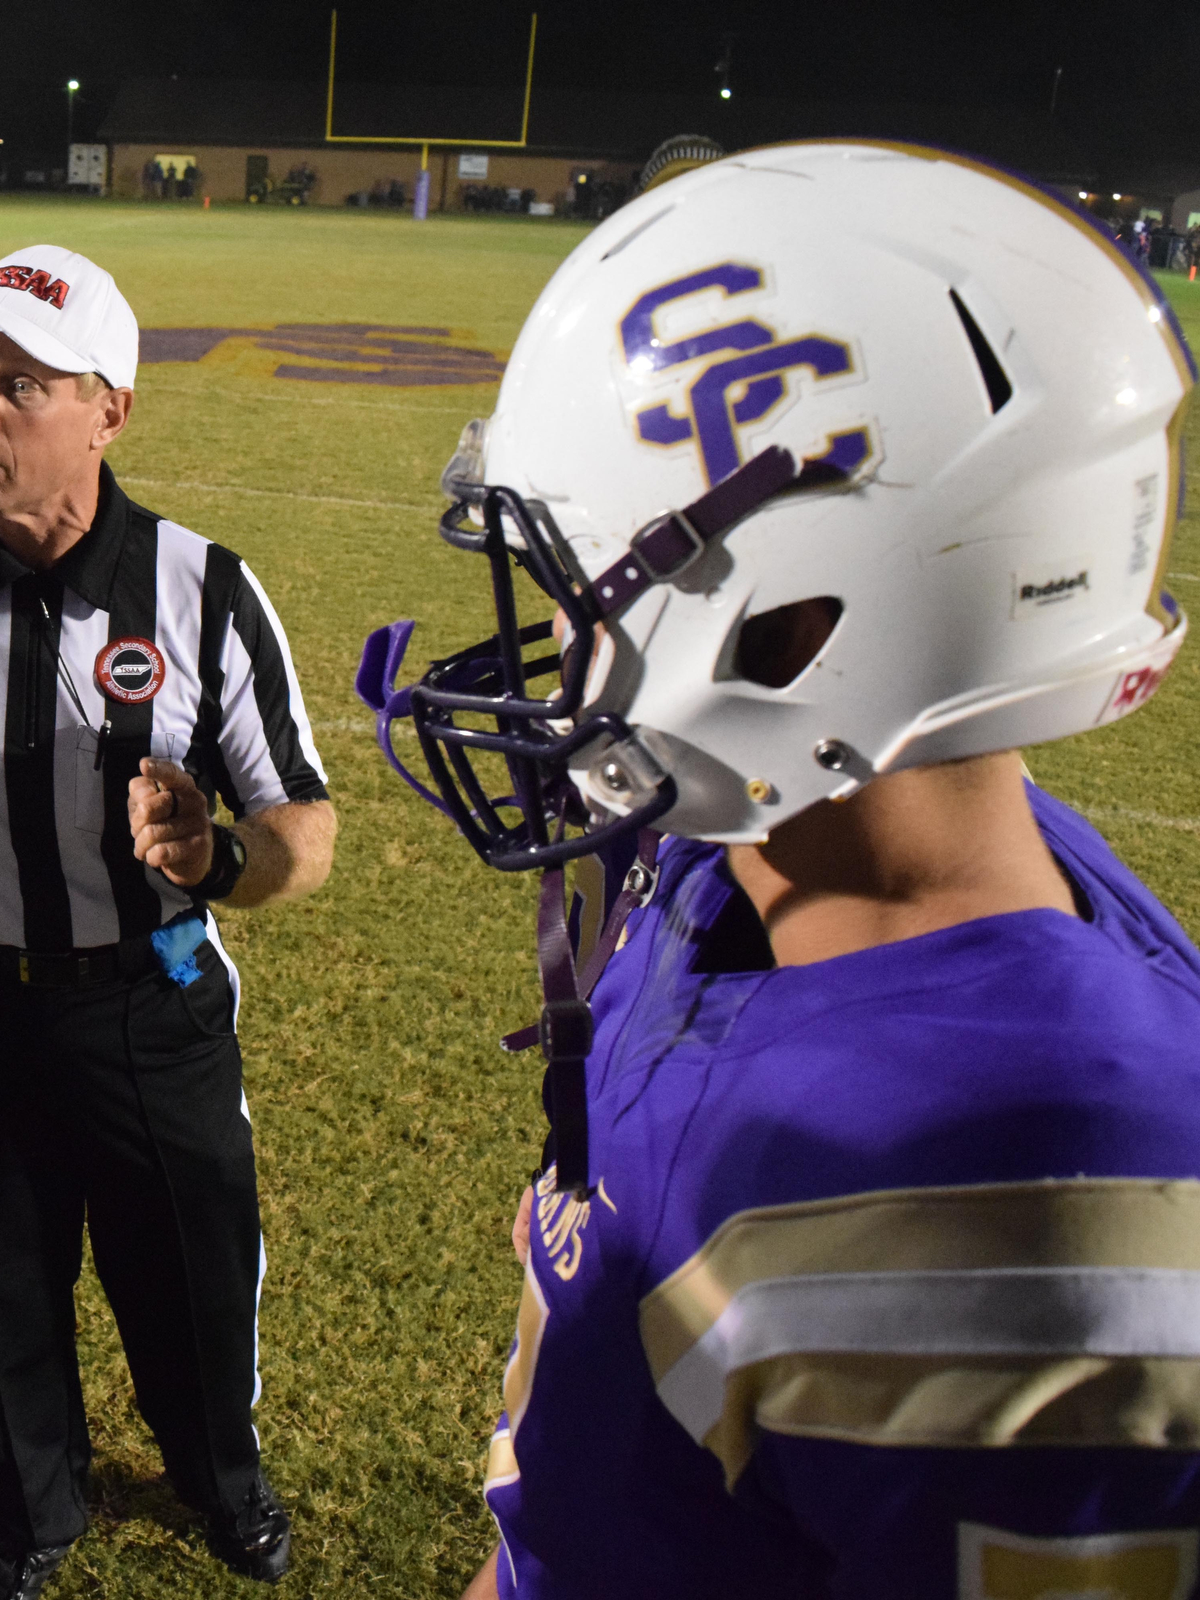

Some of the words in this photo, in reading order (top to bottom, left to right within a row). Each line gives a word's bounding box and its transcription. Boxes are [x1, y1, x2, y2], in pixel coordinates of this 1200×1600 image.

[616, 258, 874, 492] SC
[120, 642, 151, 656] Secondary
[105, 680, 127, 699] Athletic
[127, 680, 159, 700] Association
